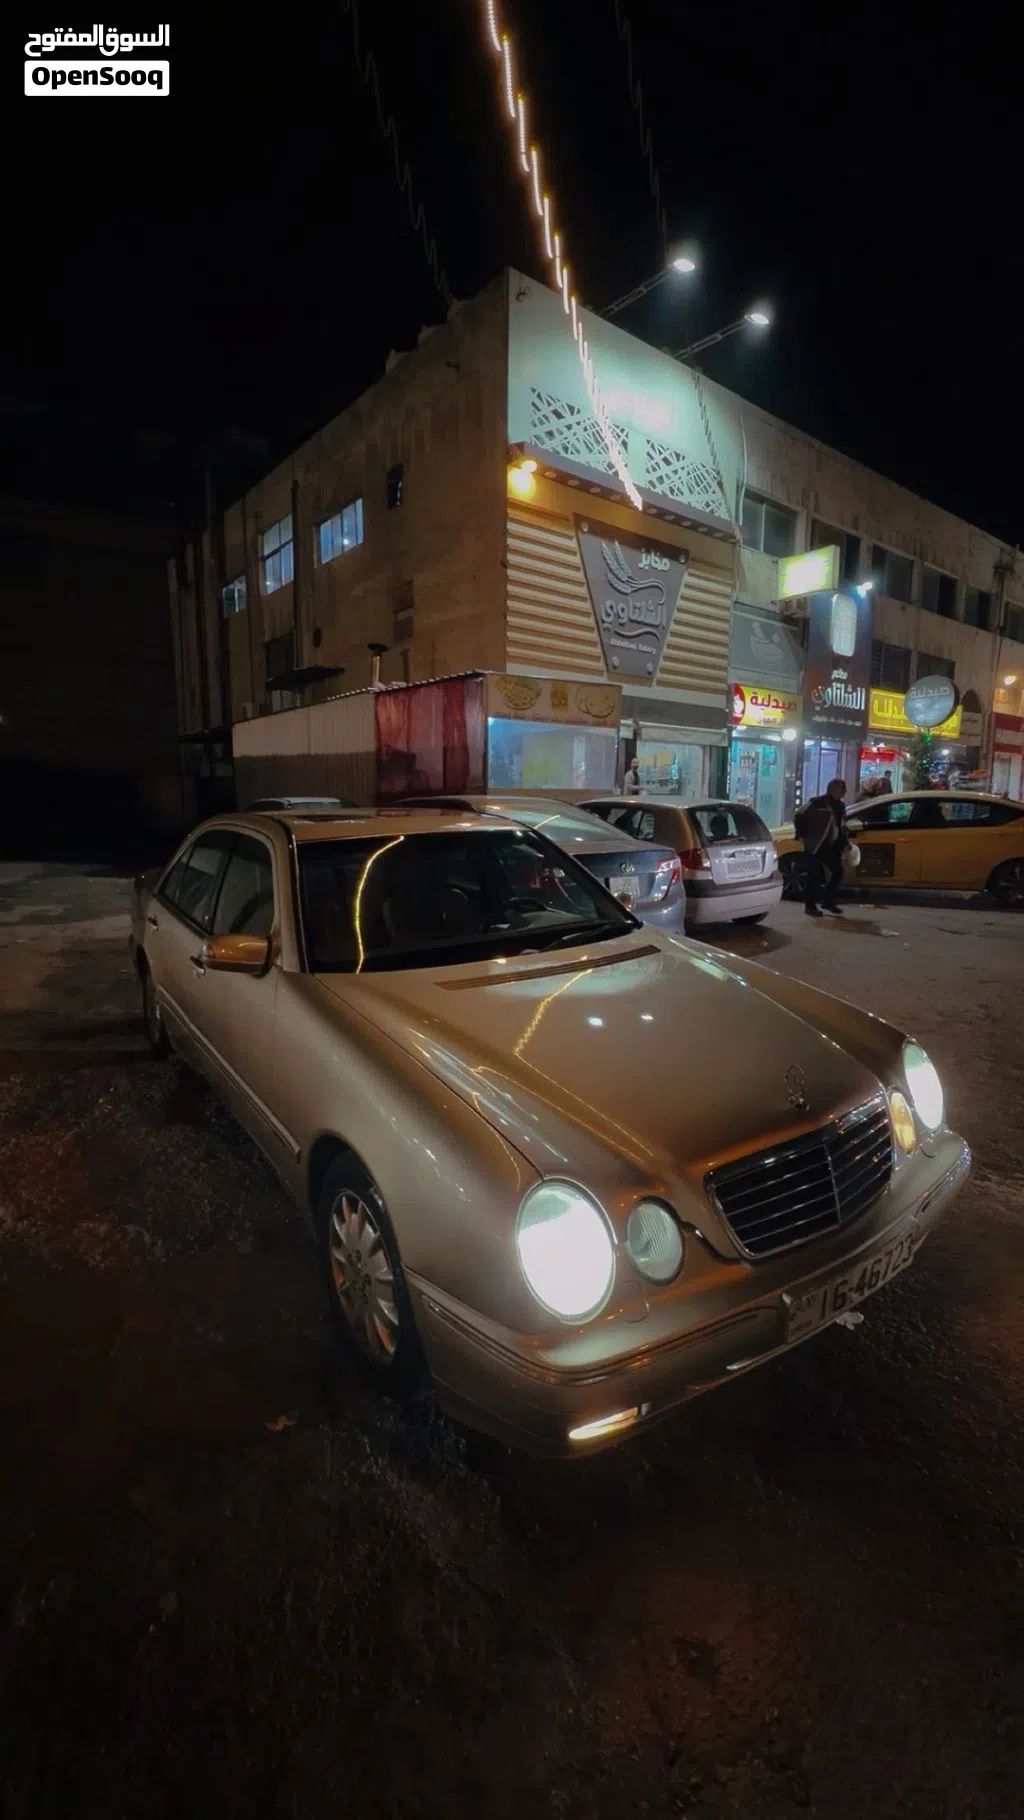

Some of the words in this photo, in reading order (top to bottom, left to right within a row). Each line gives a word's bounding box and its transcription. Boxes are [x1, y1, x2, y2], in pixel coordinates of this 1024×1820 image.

[637, 548, 670, 571] مخابز
[600, 597, 666, 631] الشلتاوي
[750, 691, 796, 713] صيدلية
[909, 687, 950, 700] صيدلية
